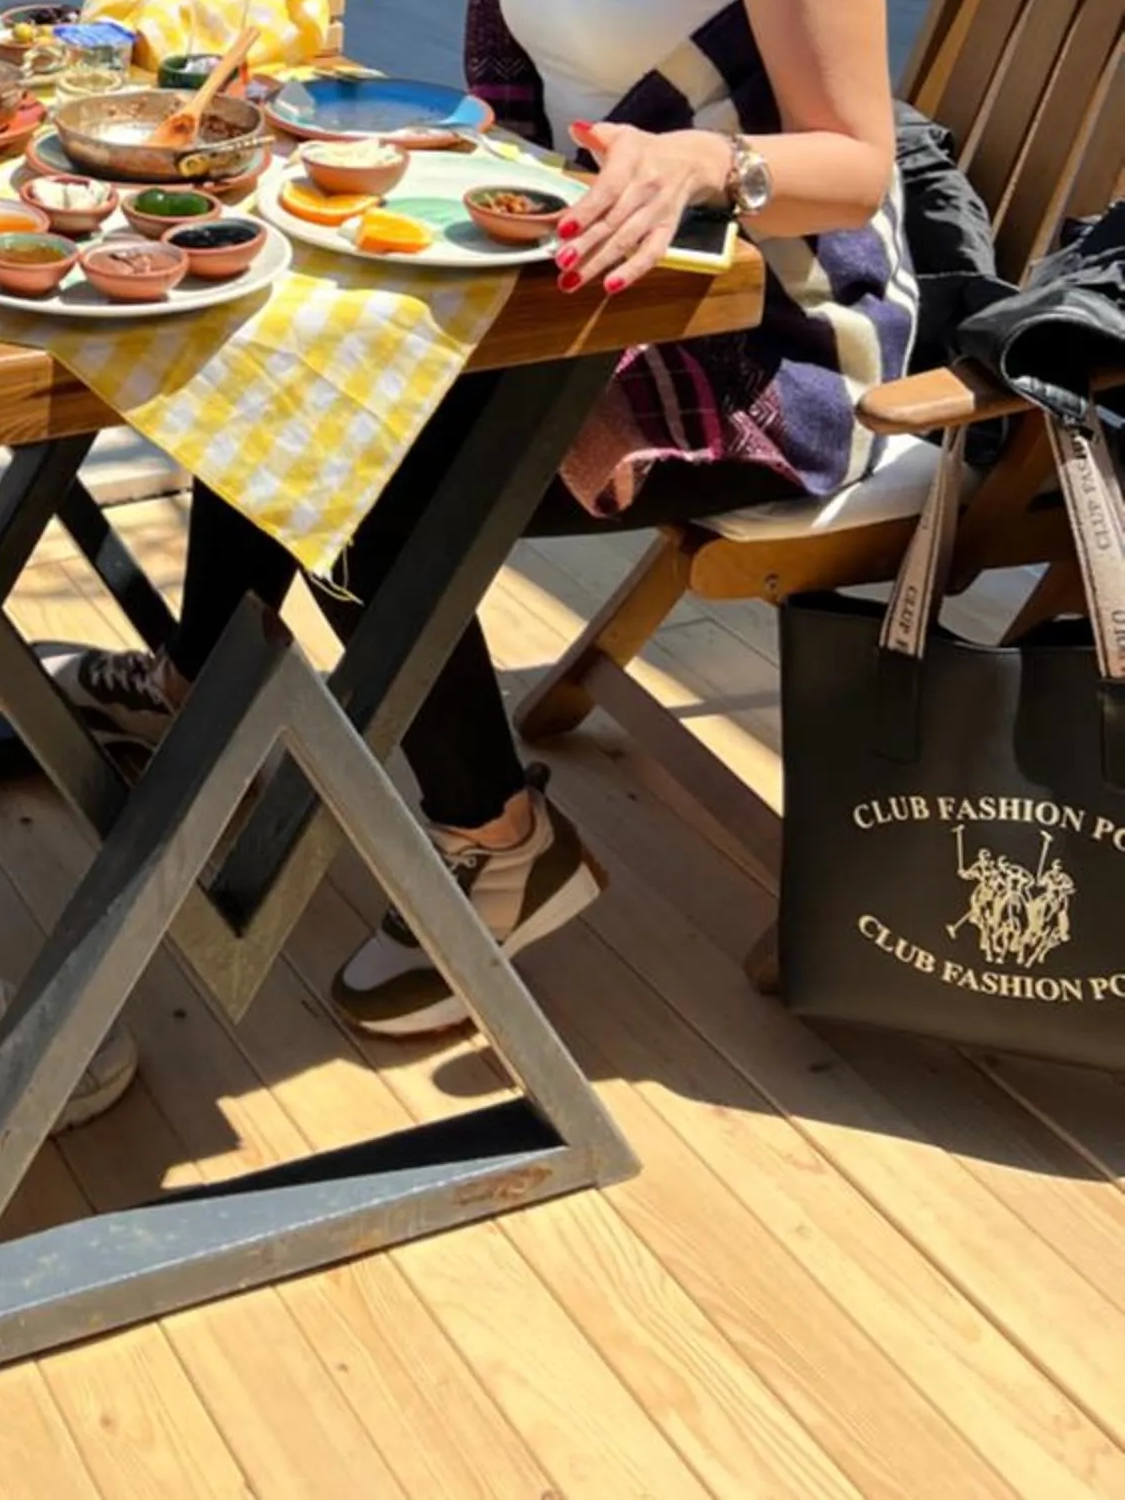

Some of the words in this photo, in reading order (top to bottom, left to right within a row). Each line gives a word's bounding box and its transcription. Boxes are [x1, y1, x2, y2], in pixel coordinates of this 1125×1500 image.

[853, 796, 930, 829] CLUB
[937, 797, 1086, 832] FASHION
[858, 915, 935, 973] CLUB
[942, 960, 1084, 1001] FASHION
